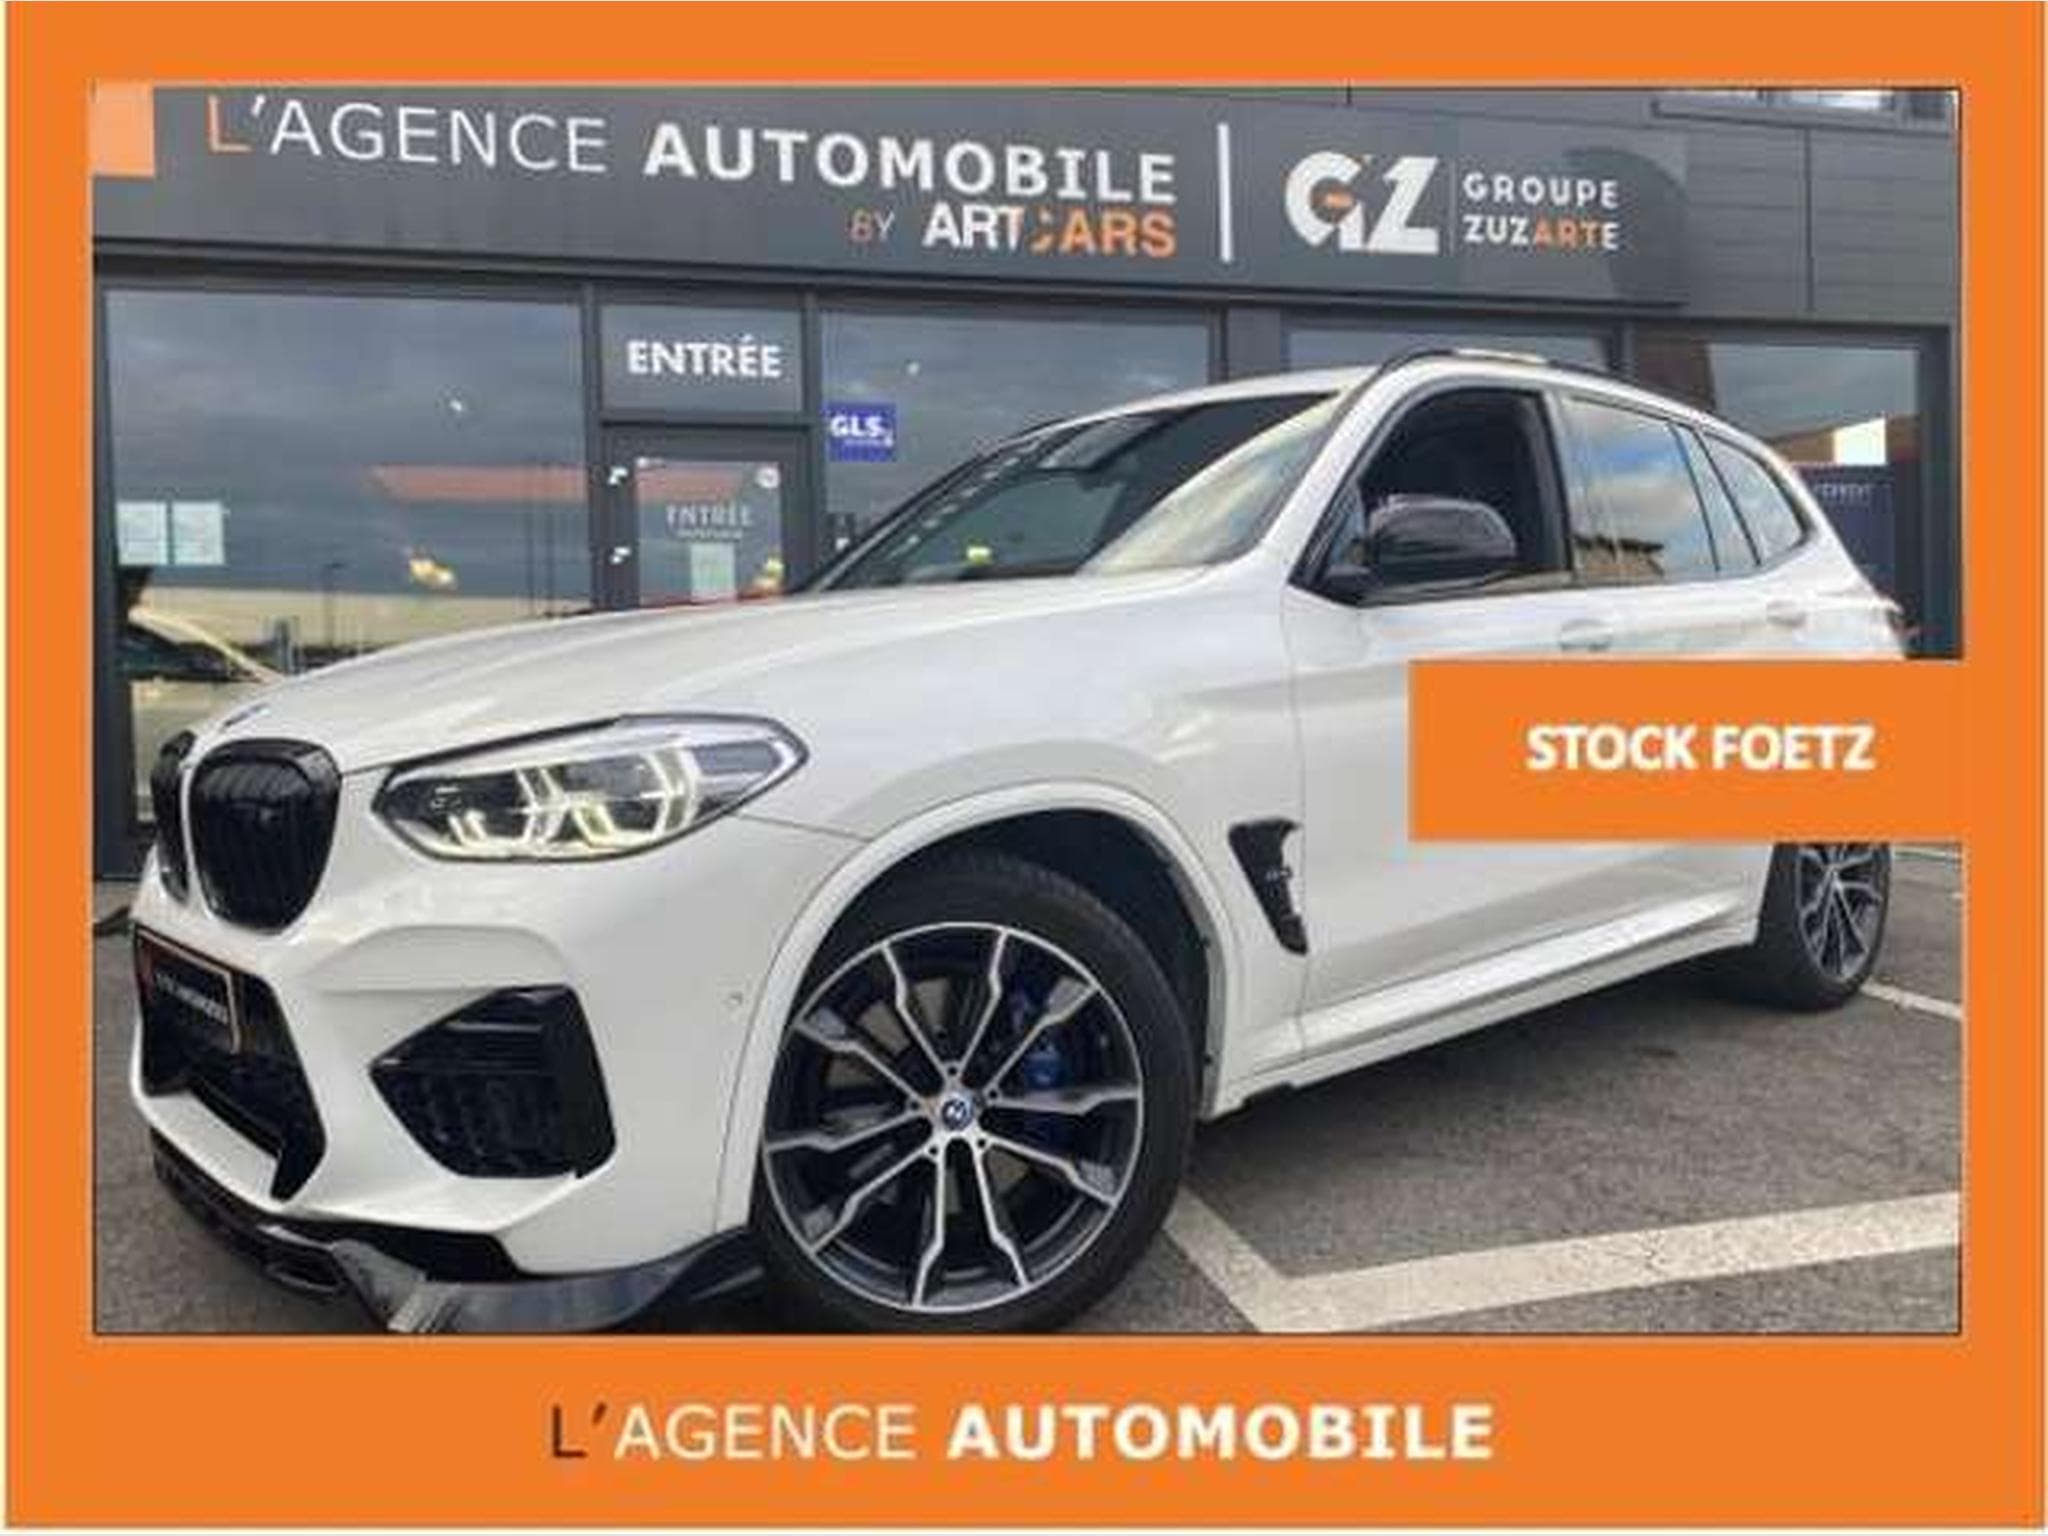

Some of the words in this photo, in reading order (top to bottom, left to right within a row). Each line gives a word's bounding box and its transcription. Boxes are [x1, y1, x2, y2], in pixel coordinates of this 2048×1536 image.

[643, 122, 1177, 203] AUTOMOBILE
[1463, 172, 1619, 209] GROUPE
[850, 210, 895, 243] BY
[1463, 214, 1619, 250] ZUZARTE
[627, 333, 782, 377] ENTRÉE
[830, 415, 884, 438] GLS
